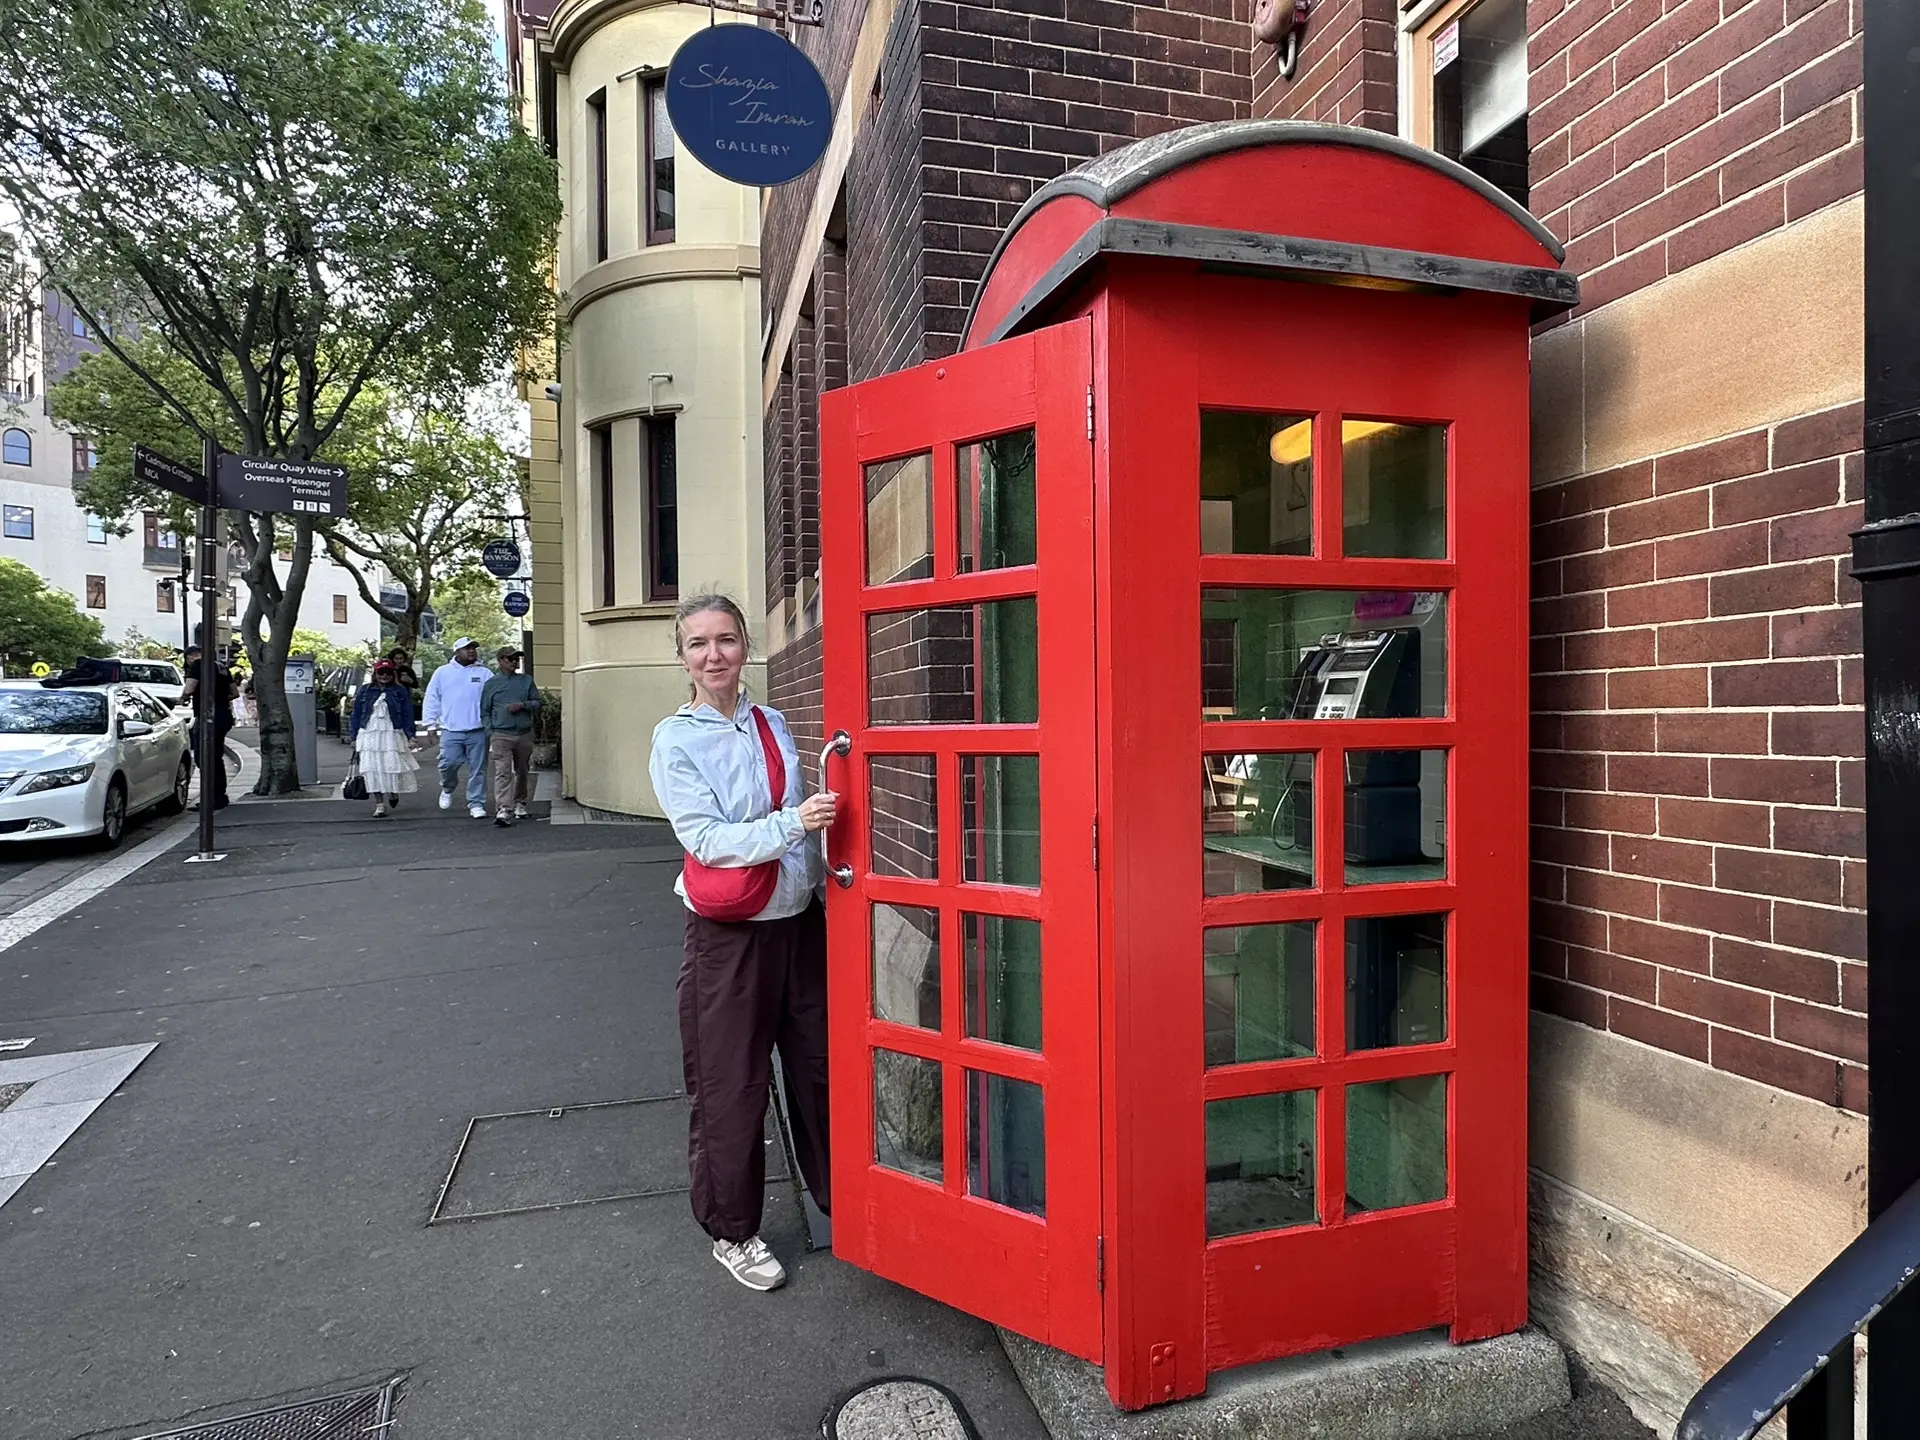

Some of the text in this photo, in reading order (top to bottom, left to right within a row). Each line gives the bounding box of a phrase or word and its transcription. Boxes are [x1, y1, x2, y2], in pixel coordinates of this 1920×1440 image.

[679, 63, 780, 106] Shazia
[735, 101, 815, 127] Imran
[715, 139, 790, 156] GALLERY
[144, 466, 159, 481] MCA
[241, 459, 332, 476] Circular Quay West
[244, 473, 332, 488] Overseas Passenger
[291, 485, 331, 497] Terminal
[484, 554, 519, 562] RAWSON
